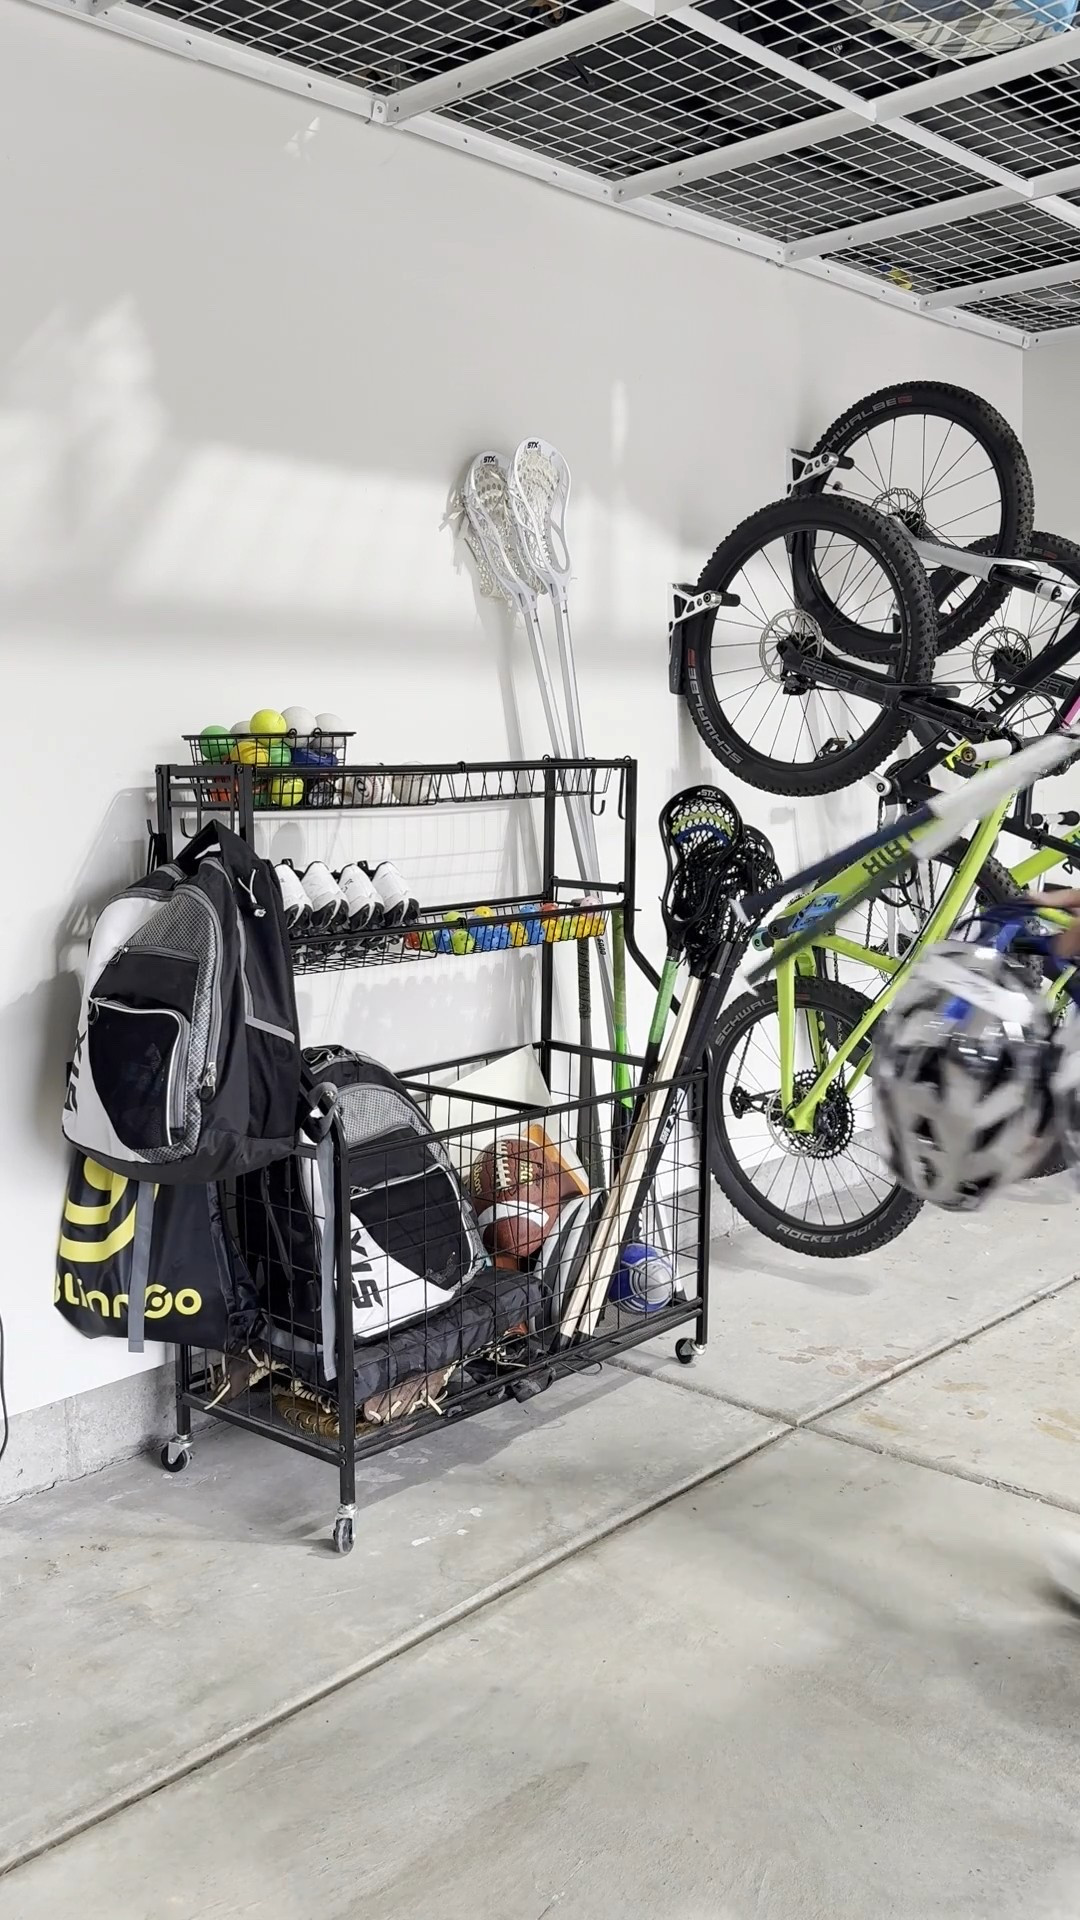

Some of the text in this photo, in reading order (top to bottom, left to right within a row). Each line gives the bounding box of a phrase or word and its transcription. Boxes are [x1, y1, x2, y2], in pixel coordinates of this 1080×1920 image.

[527, 441, 540, 449] STX
[483, 455, 496, 464] STX
[688, 667, 743, 764] SCHWALBE
[701, 789, 717, 798] STX
[776, 1223, 842, 1243] ROCKET
